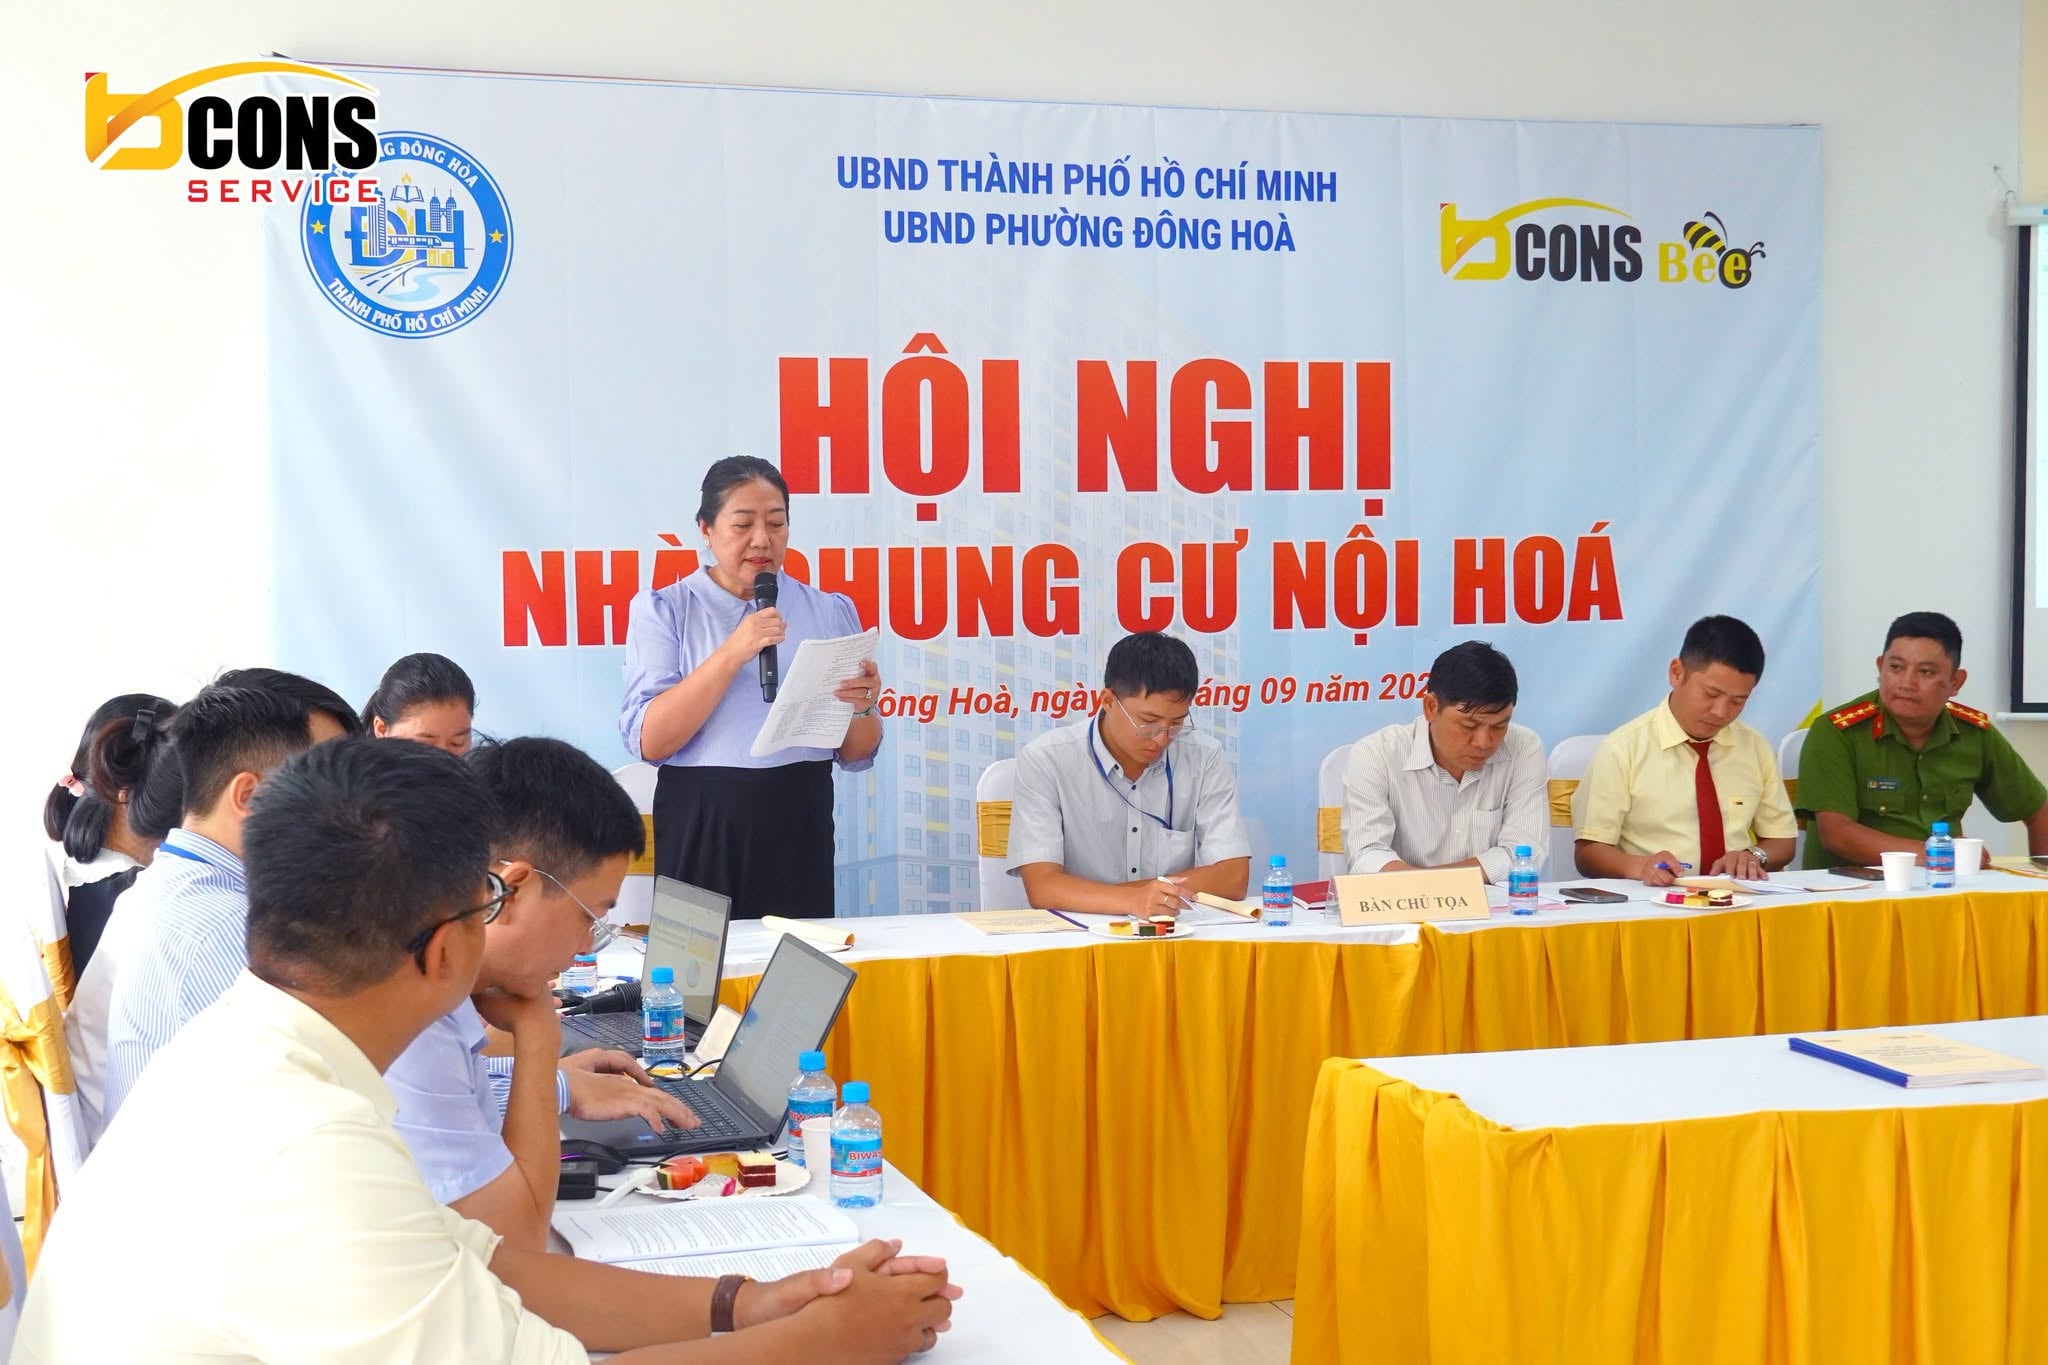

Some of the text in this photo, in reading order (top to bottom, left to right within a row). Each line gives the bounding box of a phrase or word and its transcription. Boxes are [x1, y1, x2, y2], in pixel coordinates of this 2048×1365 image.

[400, 140, 447, 164] ĐÔNG
[447, 156, 480, 188] HÒA
[837, 152, 1338, 203] UBND THÀNH PHỐ HỒ CHÍ MINH
[884, 206, 1296, 252] UBND PHƯỜNG ĐÔNG HOÀ
[1658, 242, 1752, 289] Bee
[327, 277, 489, 331] THÀNH PHỐ HỒ CHÍ MINH
[779, 332, 1391, 521] HỘI NGHỊ
[783, 544, 1080, 640] HUNG
[1116, 528, 1249, 633] CƯ
[1272, 523, 1419, 645] NỘI
[1453, 521, 1623, 625] HOÁ
[878, 672, 1430, 723] ông Hoà, ngày áng 09 năm 202
[1359, 897, 1392, 913] BÀN
[1434, 895, 1469, 910] TỌA
